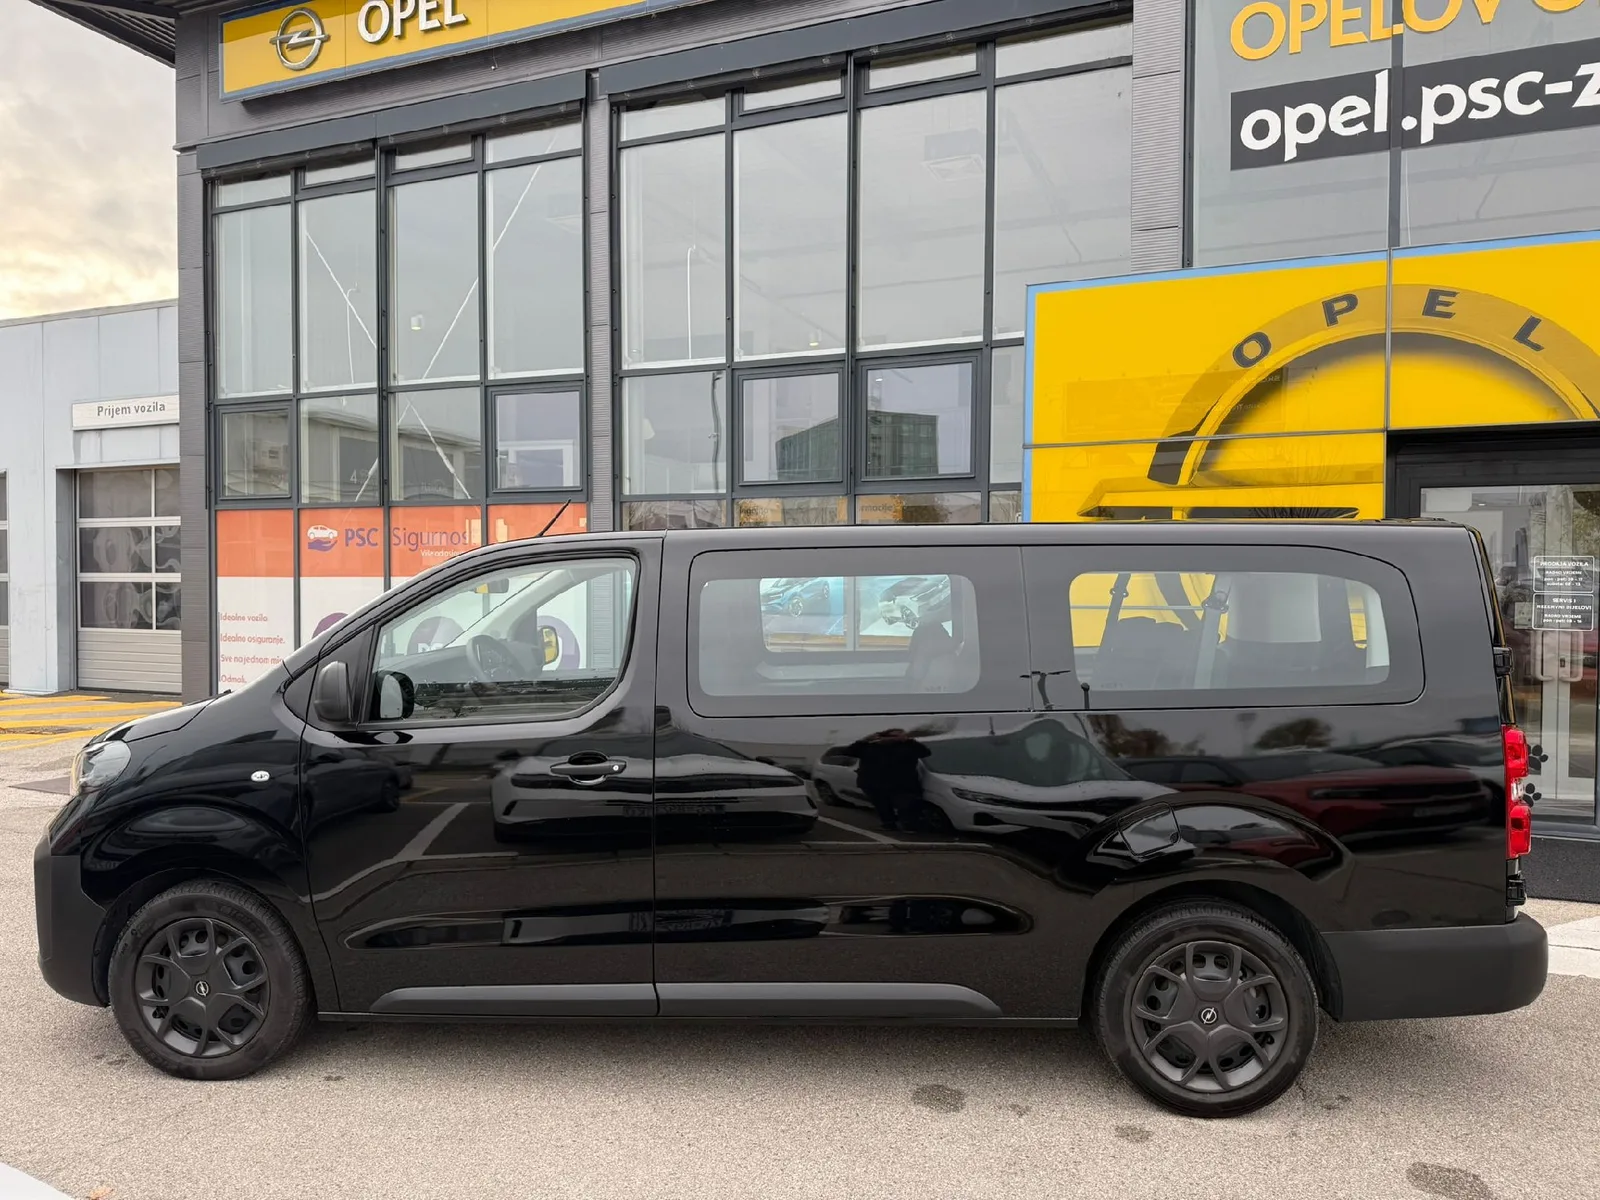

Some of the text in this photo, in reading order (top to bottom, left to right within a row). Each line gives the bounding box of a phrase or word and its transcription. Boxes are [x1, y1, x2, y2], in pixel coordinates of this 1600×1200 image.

[357, 0, 467, 43] OPEL
[1232, 287, 1546, 369] OPEL
[97, 401, 166, 418] Prijem vozila
[344, 528, 379, 547] PSC
